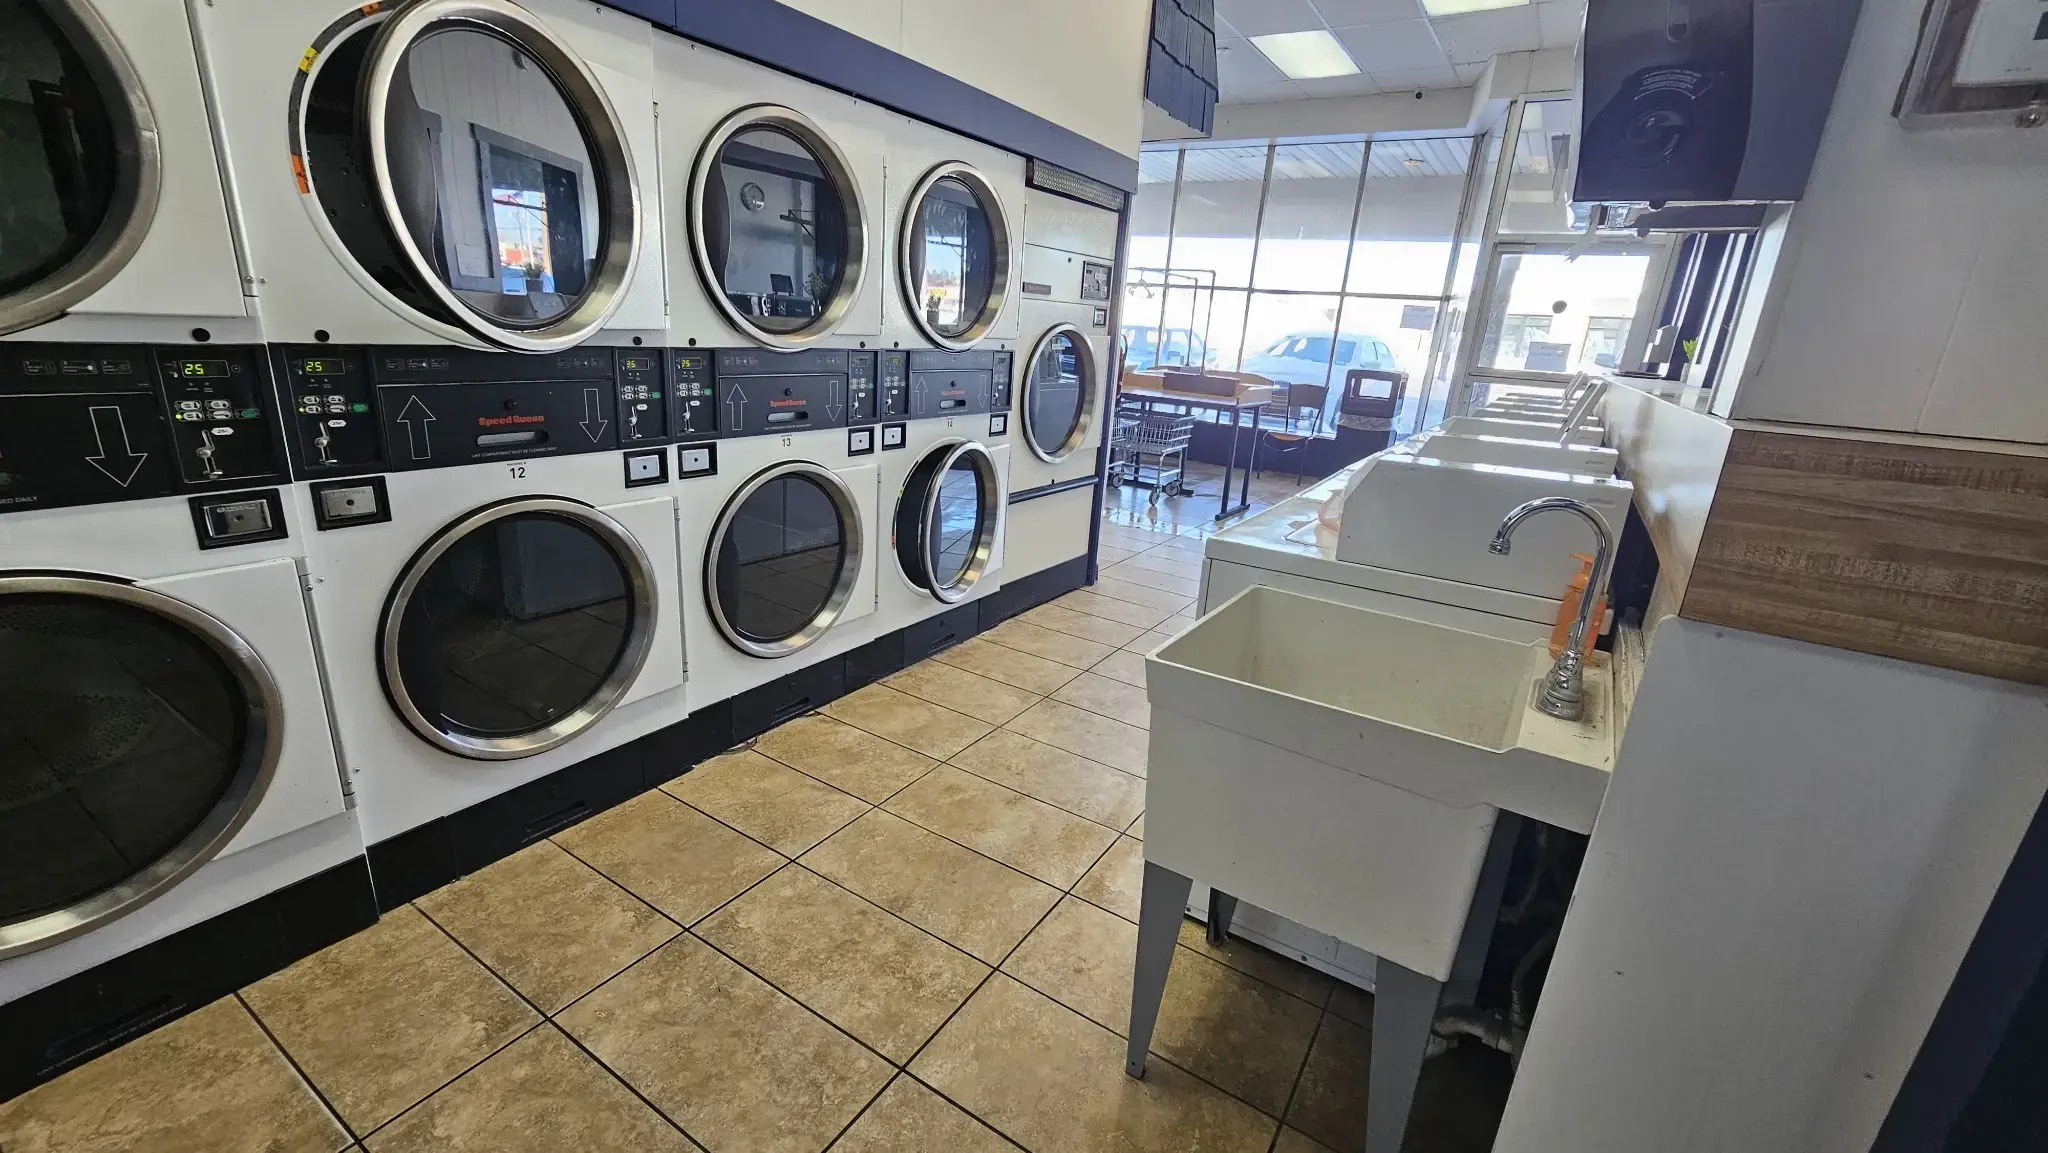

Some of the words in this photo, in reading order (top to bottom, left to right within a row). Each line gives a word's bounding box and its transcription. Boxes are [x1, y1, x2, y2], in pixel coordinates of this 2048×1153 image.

[184, 363, 204, 375] 25
[306, 361, 322, 372] 25
[479, 416, 512, 426] Speed
[513, 415, 544, 423] Queen
[782, 437, 791, 447] 13
[509, 466, 526, 479] 12
